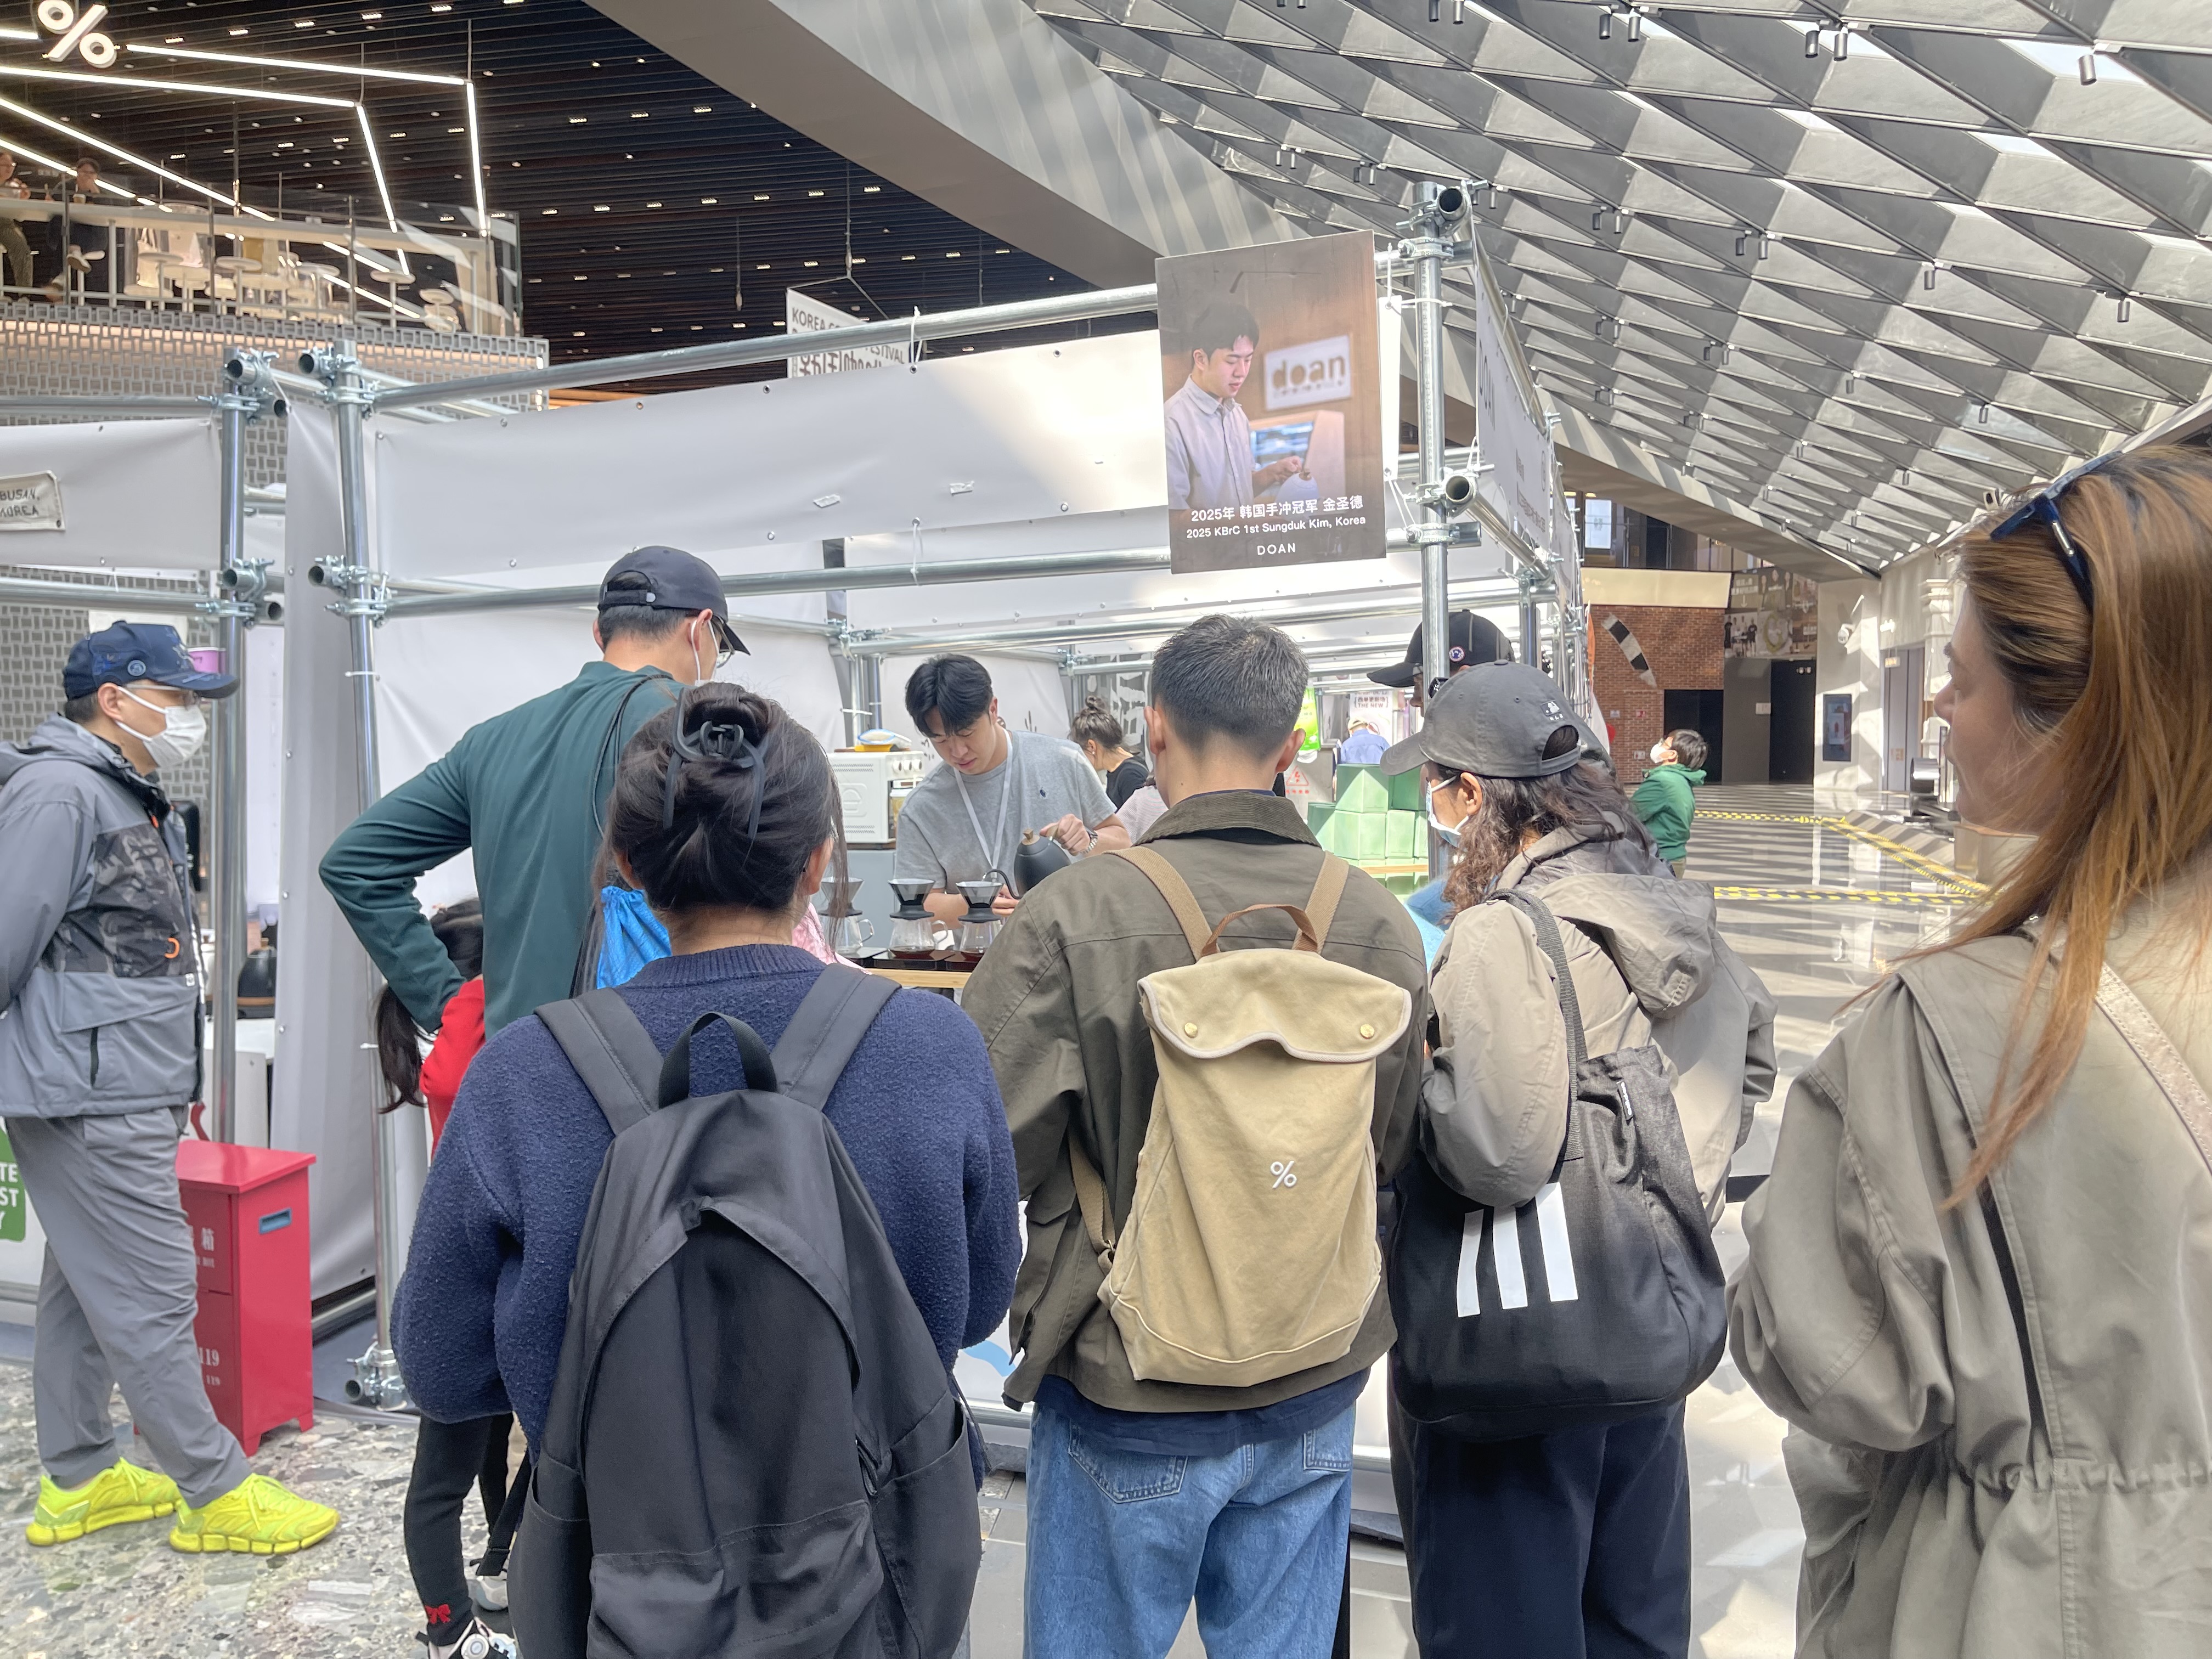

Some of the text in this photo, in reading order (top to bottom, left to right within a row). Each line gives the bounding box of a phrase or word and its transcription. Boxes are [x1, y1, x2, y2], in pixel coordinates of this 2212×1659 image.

[1272, 355, 1346, 390] doan
[1191, 495, 1363, 522] 2025年 韩国手冲冠军 金圣德
[1186, 516, 1365, 539] 2025 KBrC 1st Sungduk Kim, Korea
[1257, 543, 1296, 555] DOAN
